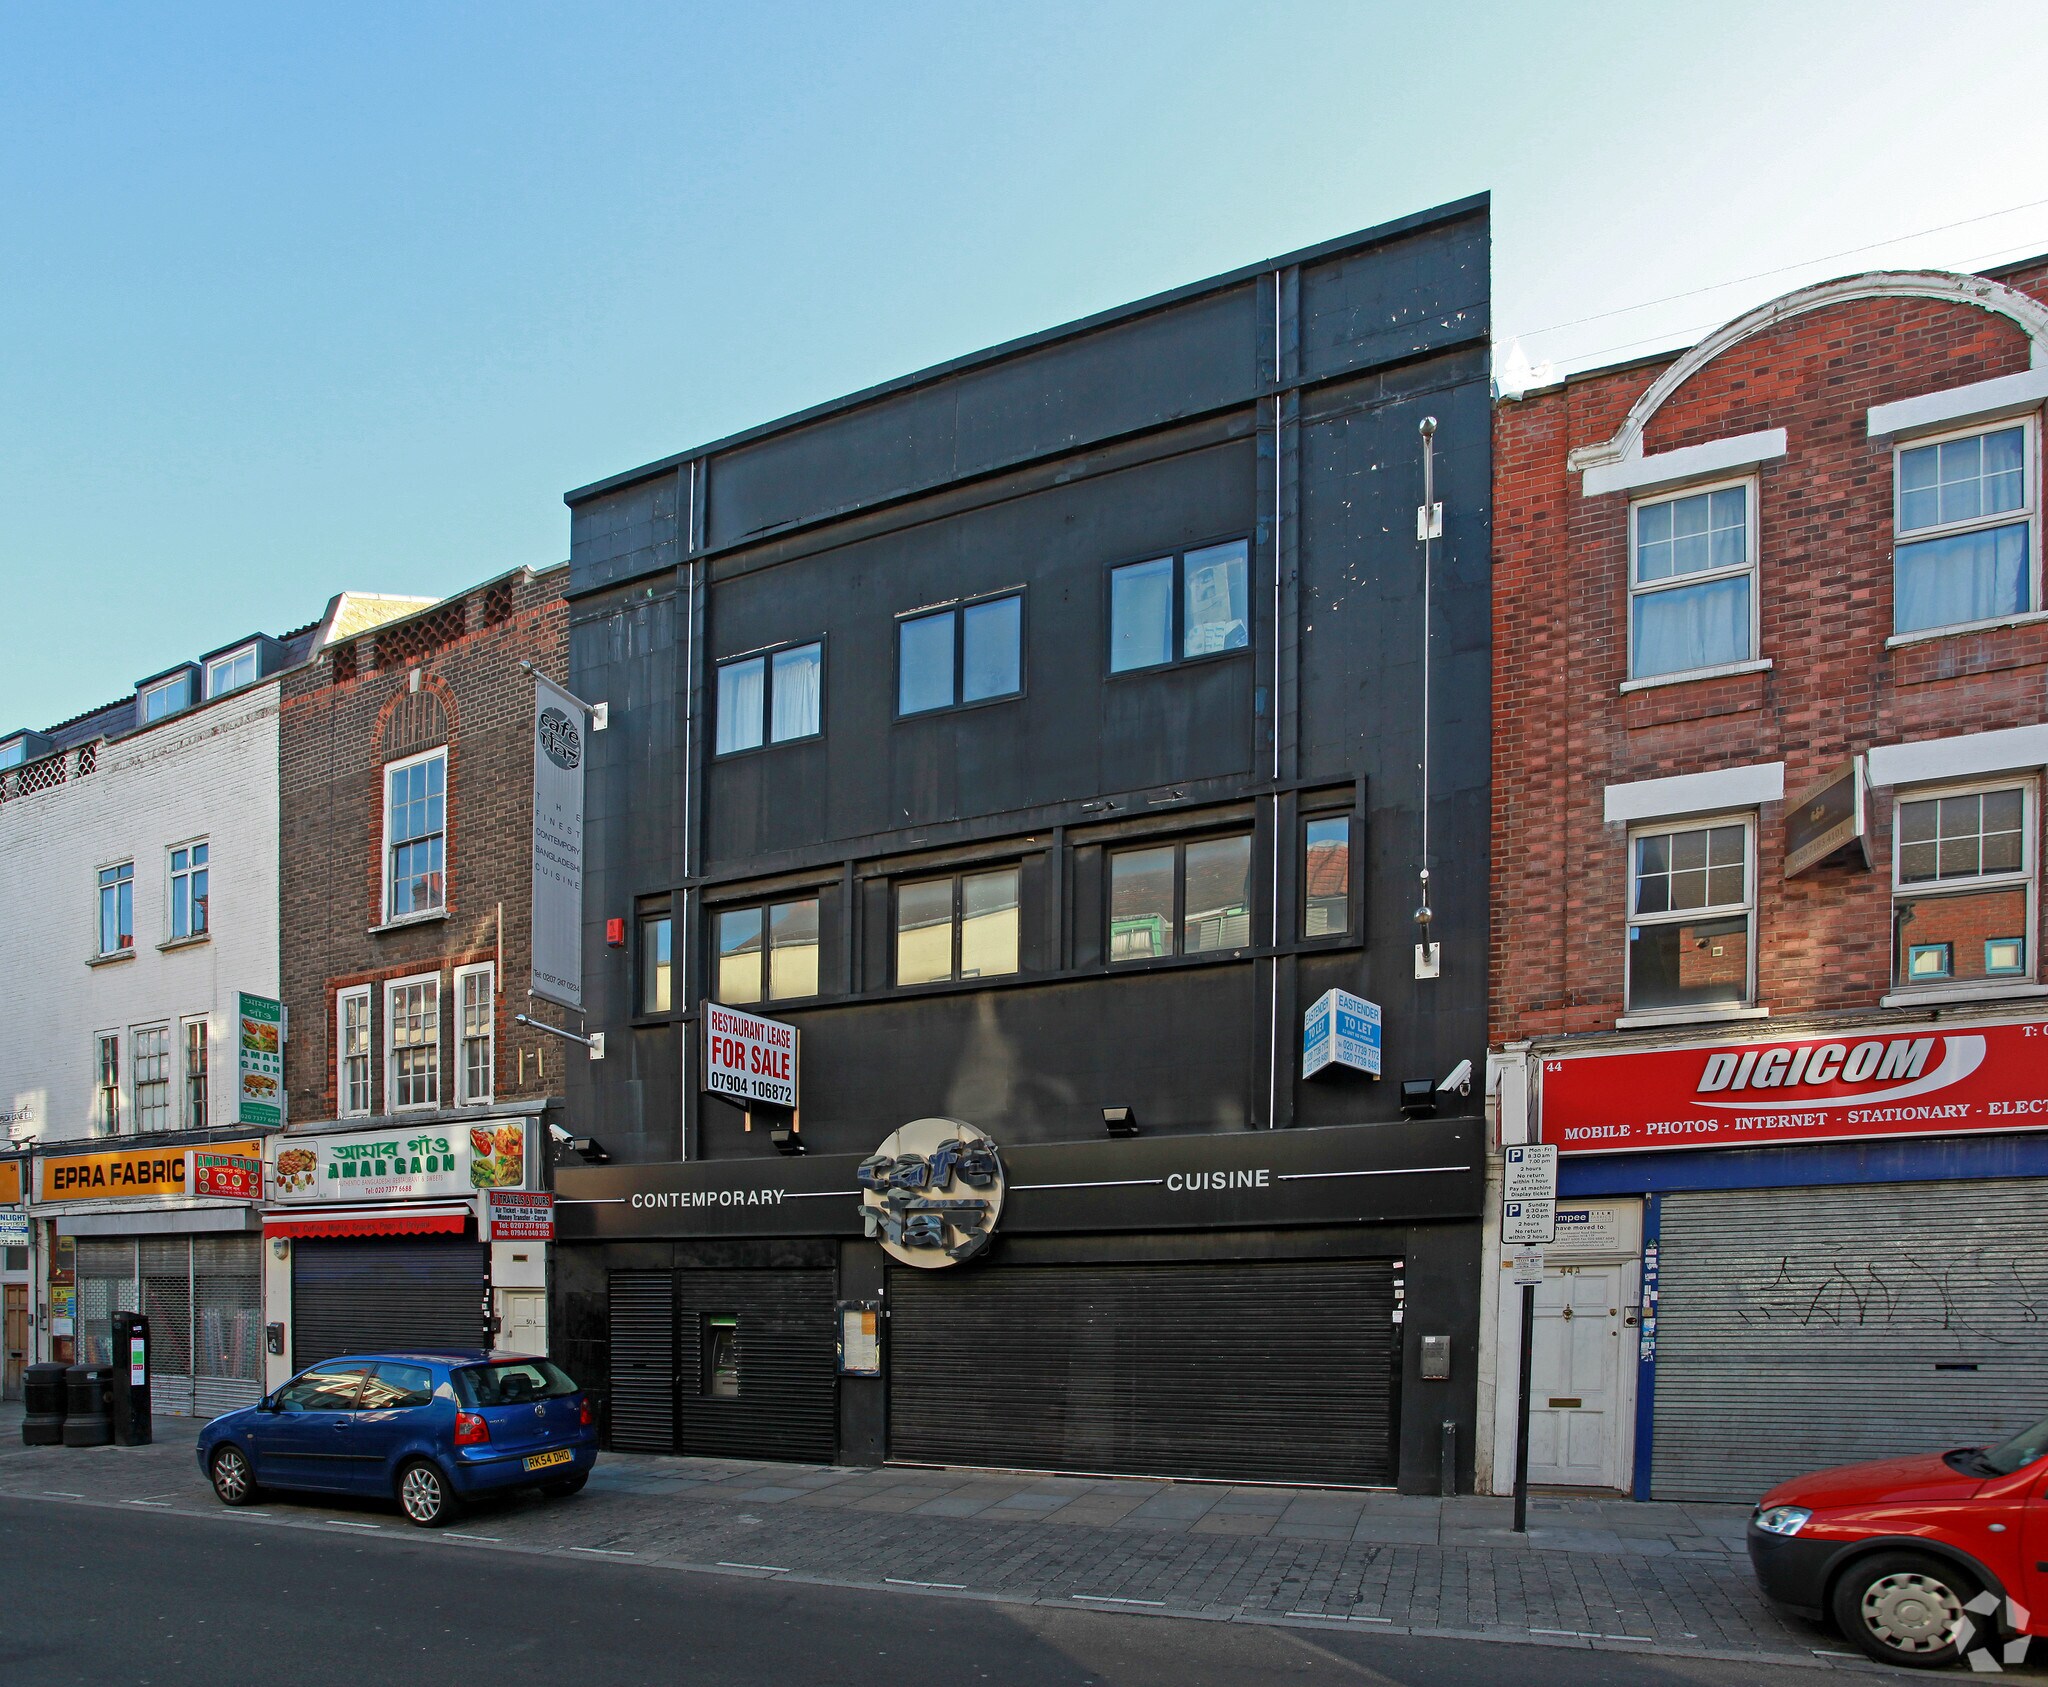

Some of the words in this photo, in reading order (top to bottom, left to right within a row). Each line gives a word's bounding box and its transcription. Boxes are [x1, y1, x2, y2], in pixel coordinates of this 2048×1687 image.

[536, 809, 580, 838] FINEST
[536, 828, 580, 856] CONTEMPORY
[536, 845, 580, 873] BANGLADESHI
[535, 863, 580, 890] CUISINE
[1338, 994, 1379, 1020] EASTENDER
[712, 1010, 765, 1042] RESTAURANT
[768, 1026, 790, 1049] LEASE
[1308, 1026, 1315, 1040] TO
[1316, 1019, 1325, 1034] LET
[1344, 1015, 1356, 1030] TO
[1358, 1020, 1372, 1035] LET
[241, 1049, 280, 1063] AMAR
[1343, 1040, 1353, 1052] 020
[242, 1060, 280, 1073] GAON
[712, 1036, 746, 1071] FOR
[751, 1045, 790, 1080] SALE
[1546, 1062, 1562, 1072] 44
[1696, 1036, 1936, 1093] DIGICOM
[712, 1072, 747, 1094] 07904
[752, 1080, 792, 1102] 106872
[1564, 1124, 1631, 1140] MOBILE
[1646, 1119, 1718, 1135] PHOTOS
[1734, 1112, 1828, 1130] INTERNET
[1847, 1104, 1970, 1124] STATIONARY
[1988, 1099, 2048, 1116] ELECT
[331, 1141, 400, 1160] আমার
[197, 1155, 228, 1168] AMAR
[231, 1158, 260, 1173] GAON
[328, 1160, 386, 1178] AMAR
[394, 1154, 454, 1174] GAON
[54, 1165, 105, 1190] EPRA
[1167, 1169, 1270, 1192] CUISINE
[500, 1194, 524, 1205] TRAVELS
[531, 1196, 550, 1206] TOURS
[632, 1189, 785, 1208] CONTEMPORARY
[529, 1455, 552, 1468] RK54
[554, 1450, 570, 1462] DHO
